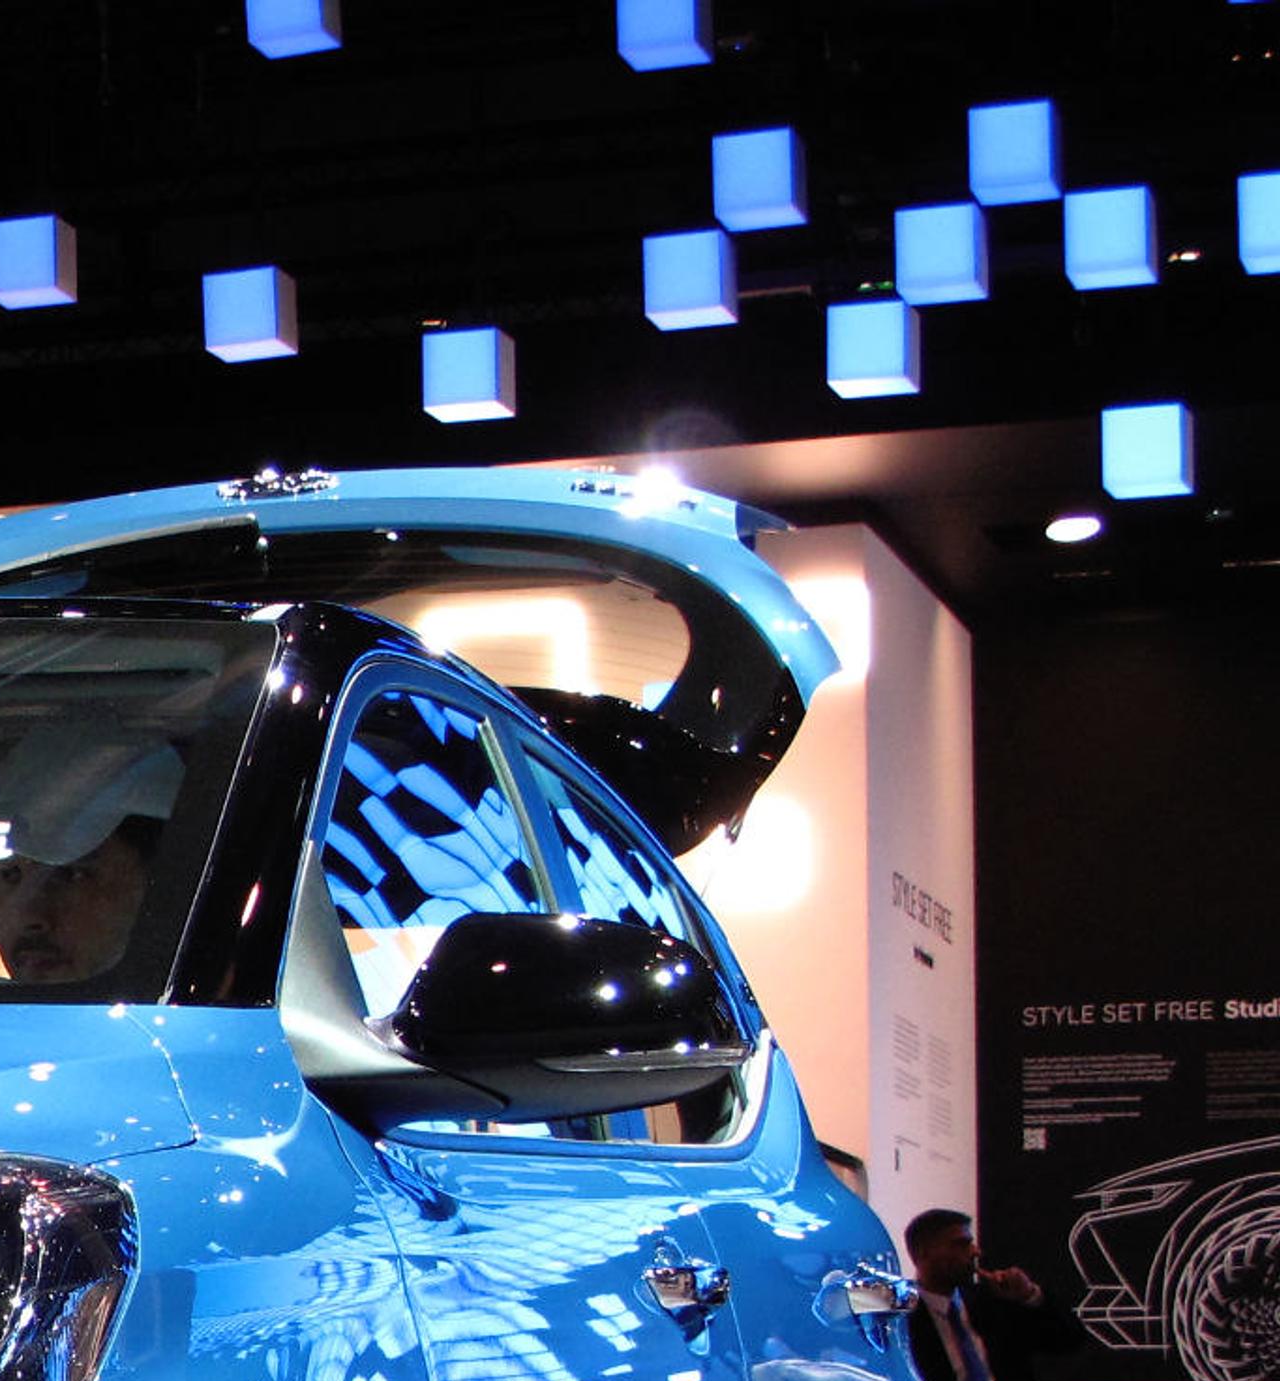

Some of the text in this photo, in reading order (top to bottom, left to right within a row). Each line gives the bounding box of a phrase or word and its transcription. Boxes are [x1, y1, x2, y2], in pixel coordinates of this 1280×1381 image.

[1023, 1005, 1095, 1027] STYLE
[1102, 1003, 1146, 1024] SET
[1154, 1000, 1213, 1021] FREE
